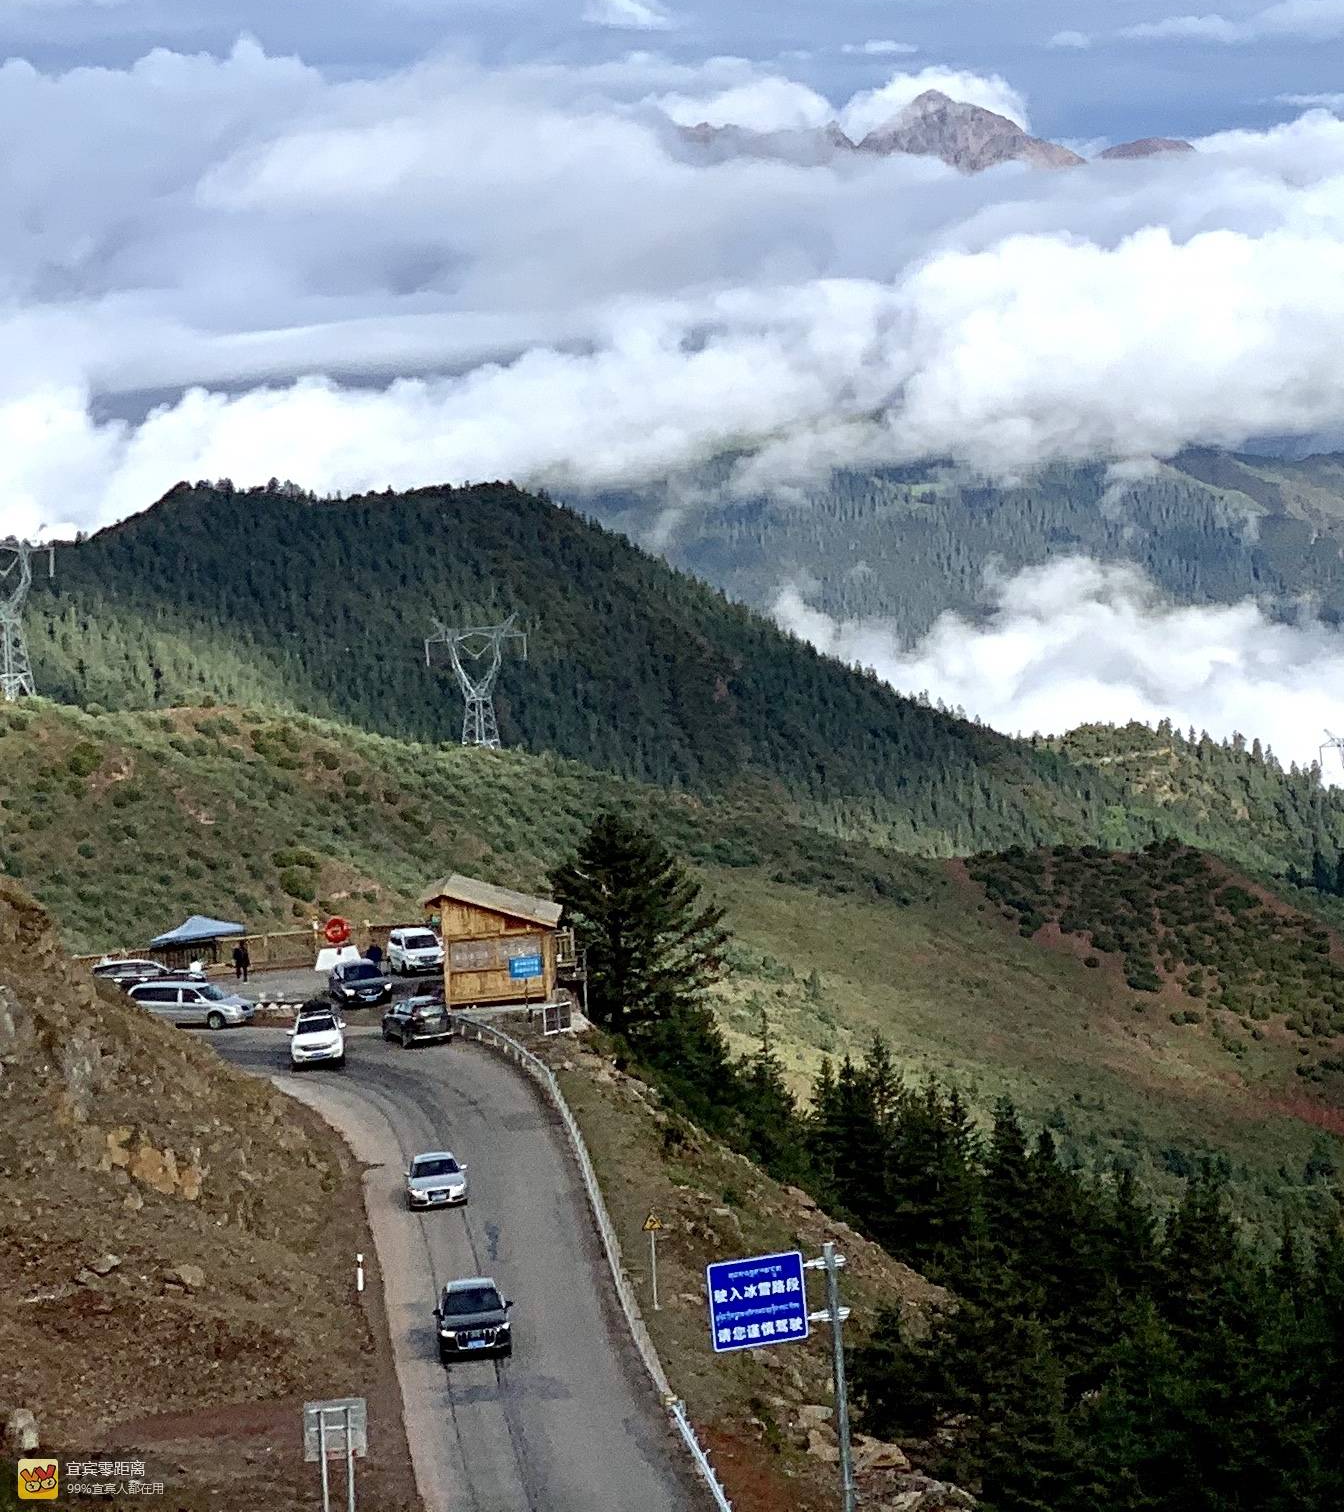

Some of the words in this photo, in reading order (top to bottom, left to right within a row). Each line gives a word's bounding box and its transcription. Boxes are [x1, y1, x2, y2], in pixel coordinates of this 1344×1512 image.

[714, 1277, 800, 1303] 驶入冰雪路段
[718, 1317, 803, 1343] 请您谨慎驾驶
